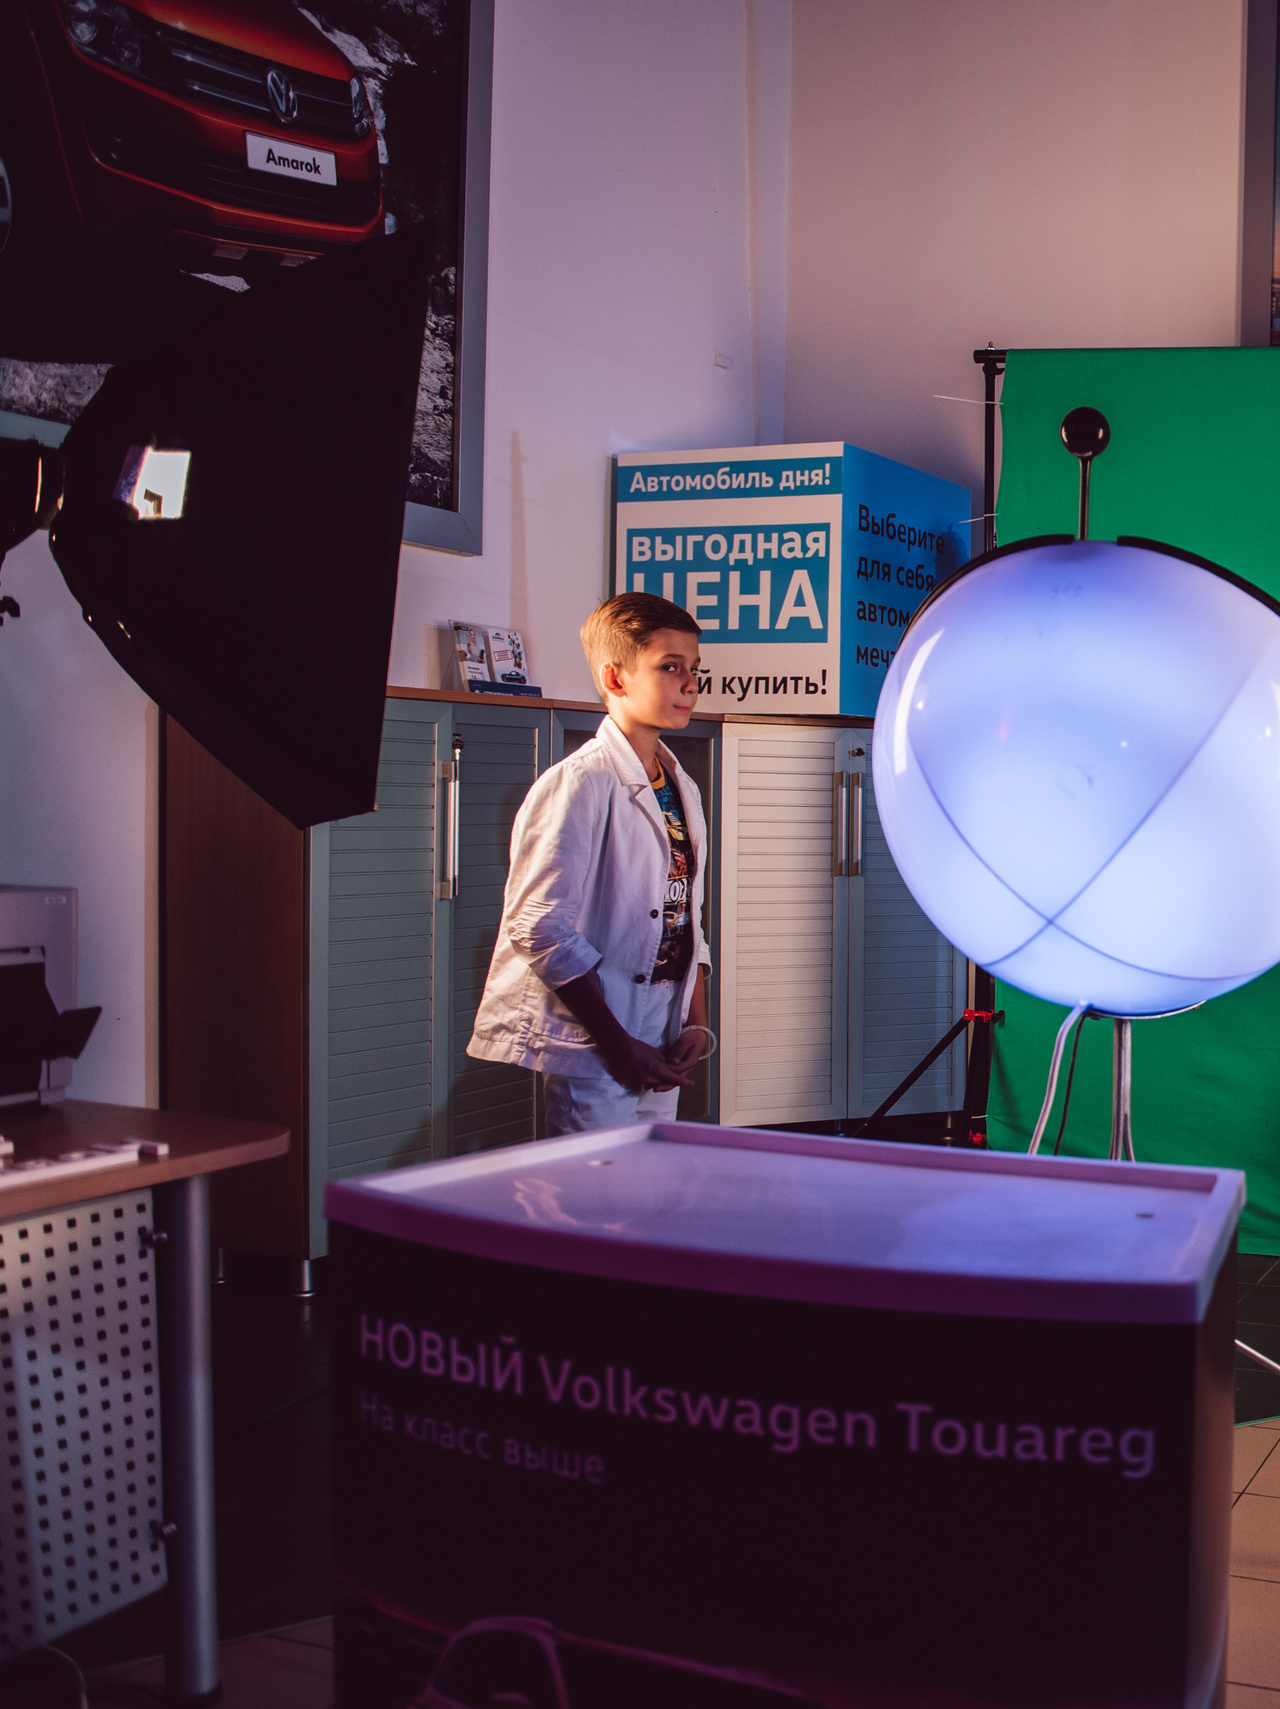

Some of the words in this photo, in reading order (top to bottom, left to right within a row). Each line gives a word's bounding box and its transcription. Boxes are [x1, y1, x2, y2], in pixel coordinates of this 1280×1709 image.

[266, 148, 321, 175] Amarok
[630, 467, 773, 493] Автомобиль
[779, 463, 831, 491] дня!
[858, 504, 945, 554] Выберите
[632, 530, 827, 566] выгодная
[857, 556, 891, 581] для
[896, 565, 934, 592] себя
[856, 600, 914, 628] автом
[721, 669, 827, 702] купить!
[359, 1312, 525, 1398] НОВЫЙ
[537, 1354, 878, 1454] Volkswagen
[896, 1400, 1156, 1480] Touareg
[359, 1389, 394, 1432] На
[404, 1412, 492, 1460] класс
[504, 1438, 606, 1486] выше
